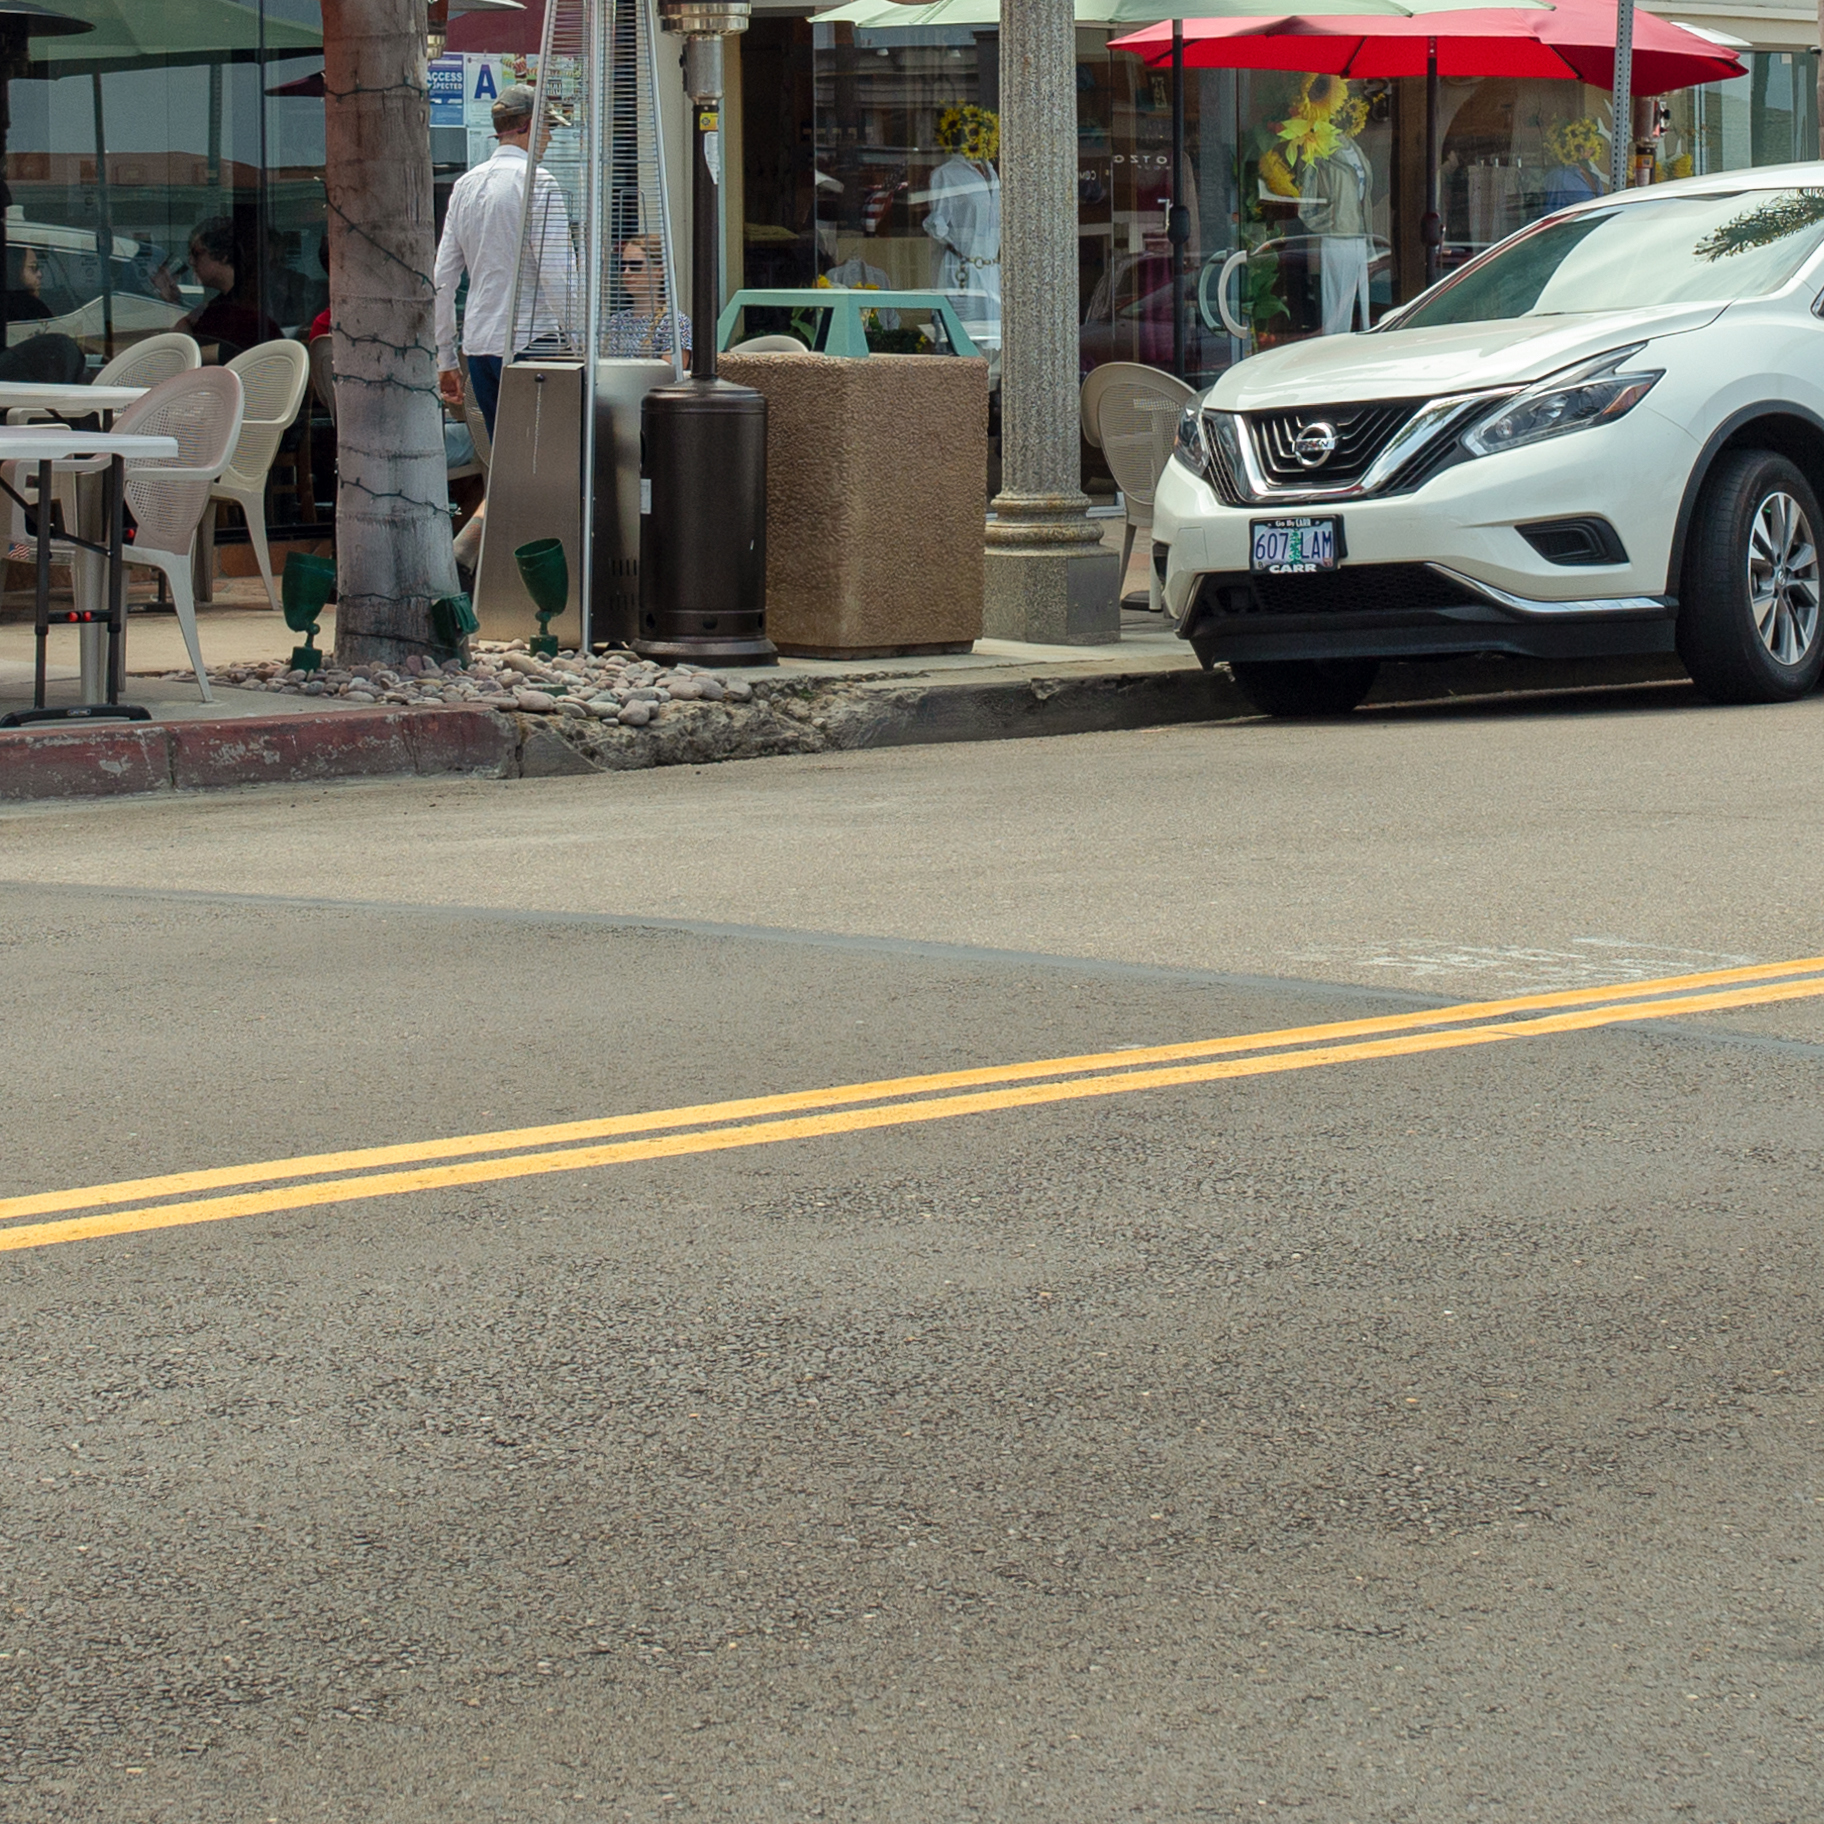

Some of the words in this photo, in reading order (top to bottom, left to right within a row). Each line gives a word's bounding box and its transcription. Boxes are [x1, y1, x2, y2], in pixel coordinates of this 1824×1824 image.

[474, 64, 498, 99] A
[1255, 532, 1289, 560] 607
[1300, 531, 1332, 559] LAM
[1269, 563, 1317, 574] CARR
